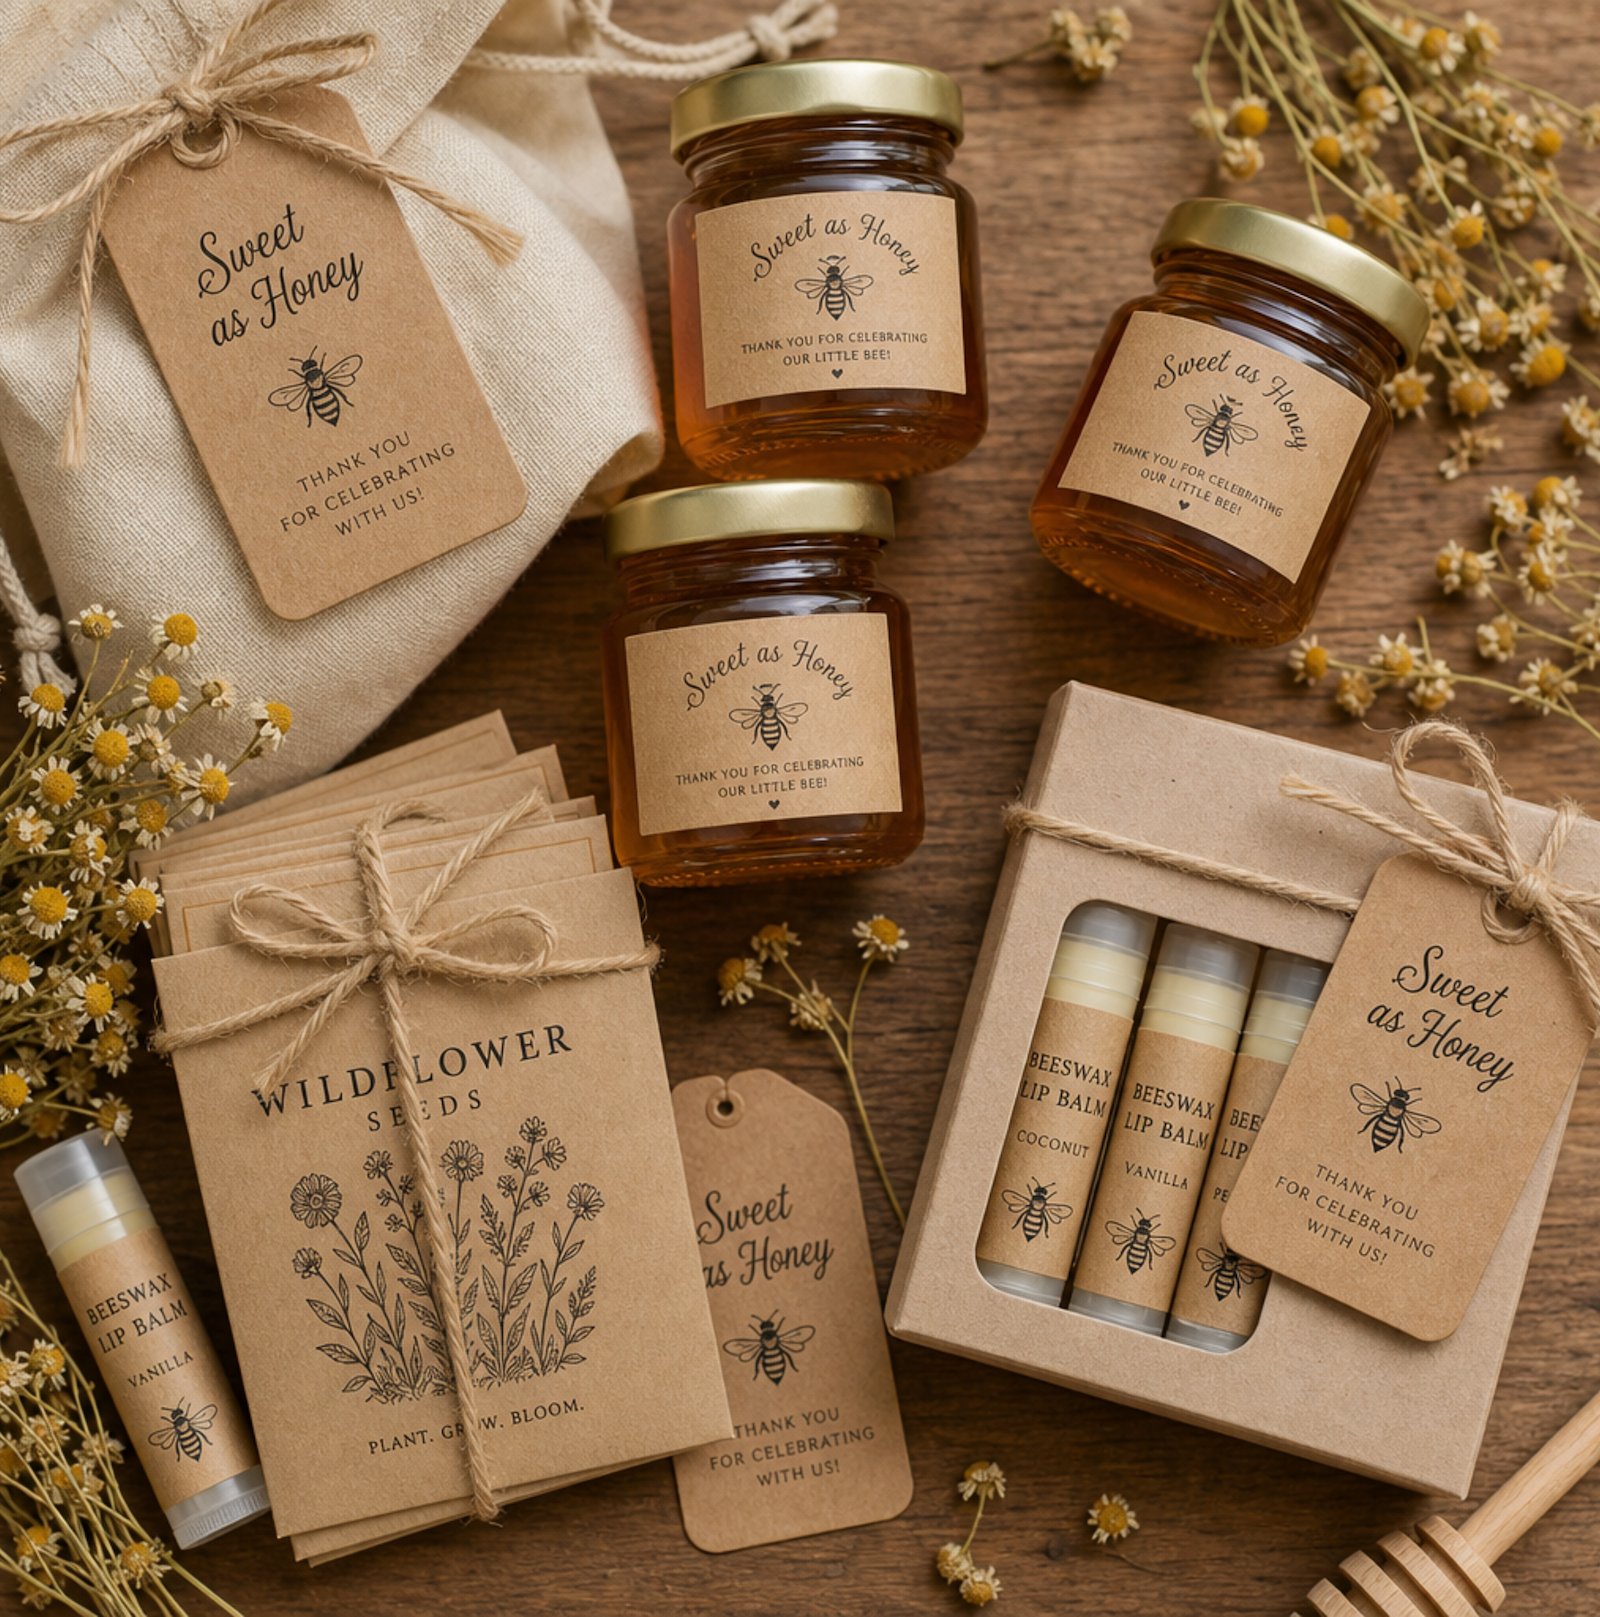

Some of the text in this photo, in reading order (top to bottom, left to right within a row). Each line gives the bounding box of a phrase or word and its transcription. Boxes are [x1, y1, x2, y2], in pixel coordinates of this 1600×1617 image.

[198, 204, 304, 299] Sweet
[751, 213, 920, 282] Sweet as Honey
[211, 252, 363, 346] as Honey
[741, 331, 928, 354] THANK YOU FOR CELEBRATING
[783, 349, 891, 366] OUR LITTLE BEE!
[1153, 350, 1309, 452] Sweet as Honey
[297, 430, 411, 493] THANK YOU
[1112, 442, 1284, 518] THANK YOU FOR CELEBRATING
[280, 443, 455, 532] FOR CELEBRATING
[335, 487, 425, 536] WITH US!
[1140, 467, 1242, 516] OUR LITTLE BEE!
[683, 639, 853, 711] Sweet as Honey
[676, 756, 864, 786] THANK YOU FOR CELEBRATING
[718, 777, 828, 798] OUR LITTLE BEE!
[1392, 945, 1509, 1018] Sweet
[1029, 1051, 1112, 1088] BEESWAX
[1367, 1004, 1514, 1093] as Honey
[1020, 1080, 1107, 1118] LIP BALM
[1133, 1083, 1215, 1121] BEESWAX
[1017, 1129, 1089, 1158] COCONUT
[1124, 1111, 1209, 1151] LIP BALM
[1220, 1138, 1248, 1160] LIP
[1125, 1161, 1188, 1190] VANILLA
[1316, 1164, 1419, 1221] THANK YOU
[696, 1183, 793, 1245] Sweet
[1274, 1175, 1436, 1259] FOR CELEBRATING
[738, 1236, 835, 1286] Honey
[1307, 1217, 1388, 1266] WITH US!
[86, 1273, 172, 1325] BEESWAX
[98, 1299, 188, 1354] LIP BALM
[128, 1351, 194, 1388] VANILLA
[369, 1398, 585, 1455] PLANT. GRW. BLOOM.
[733, 1407, 839, 1439] THANK YOU
[709, 1426, 875, 1471] FOR CELEBRATING
[757, 1459, 840, 1487] WITH US!
